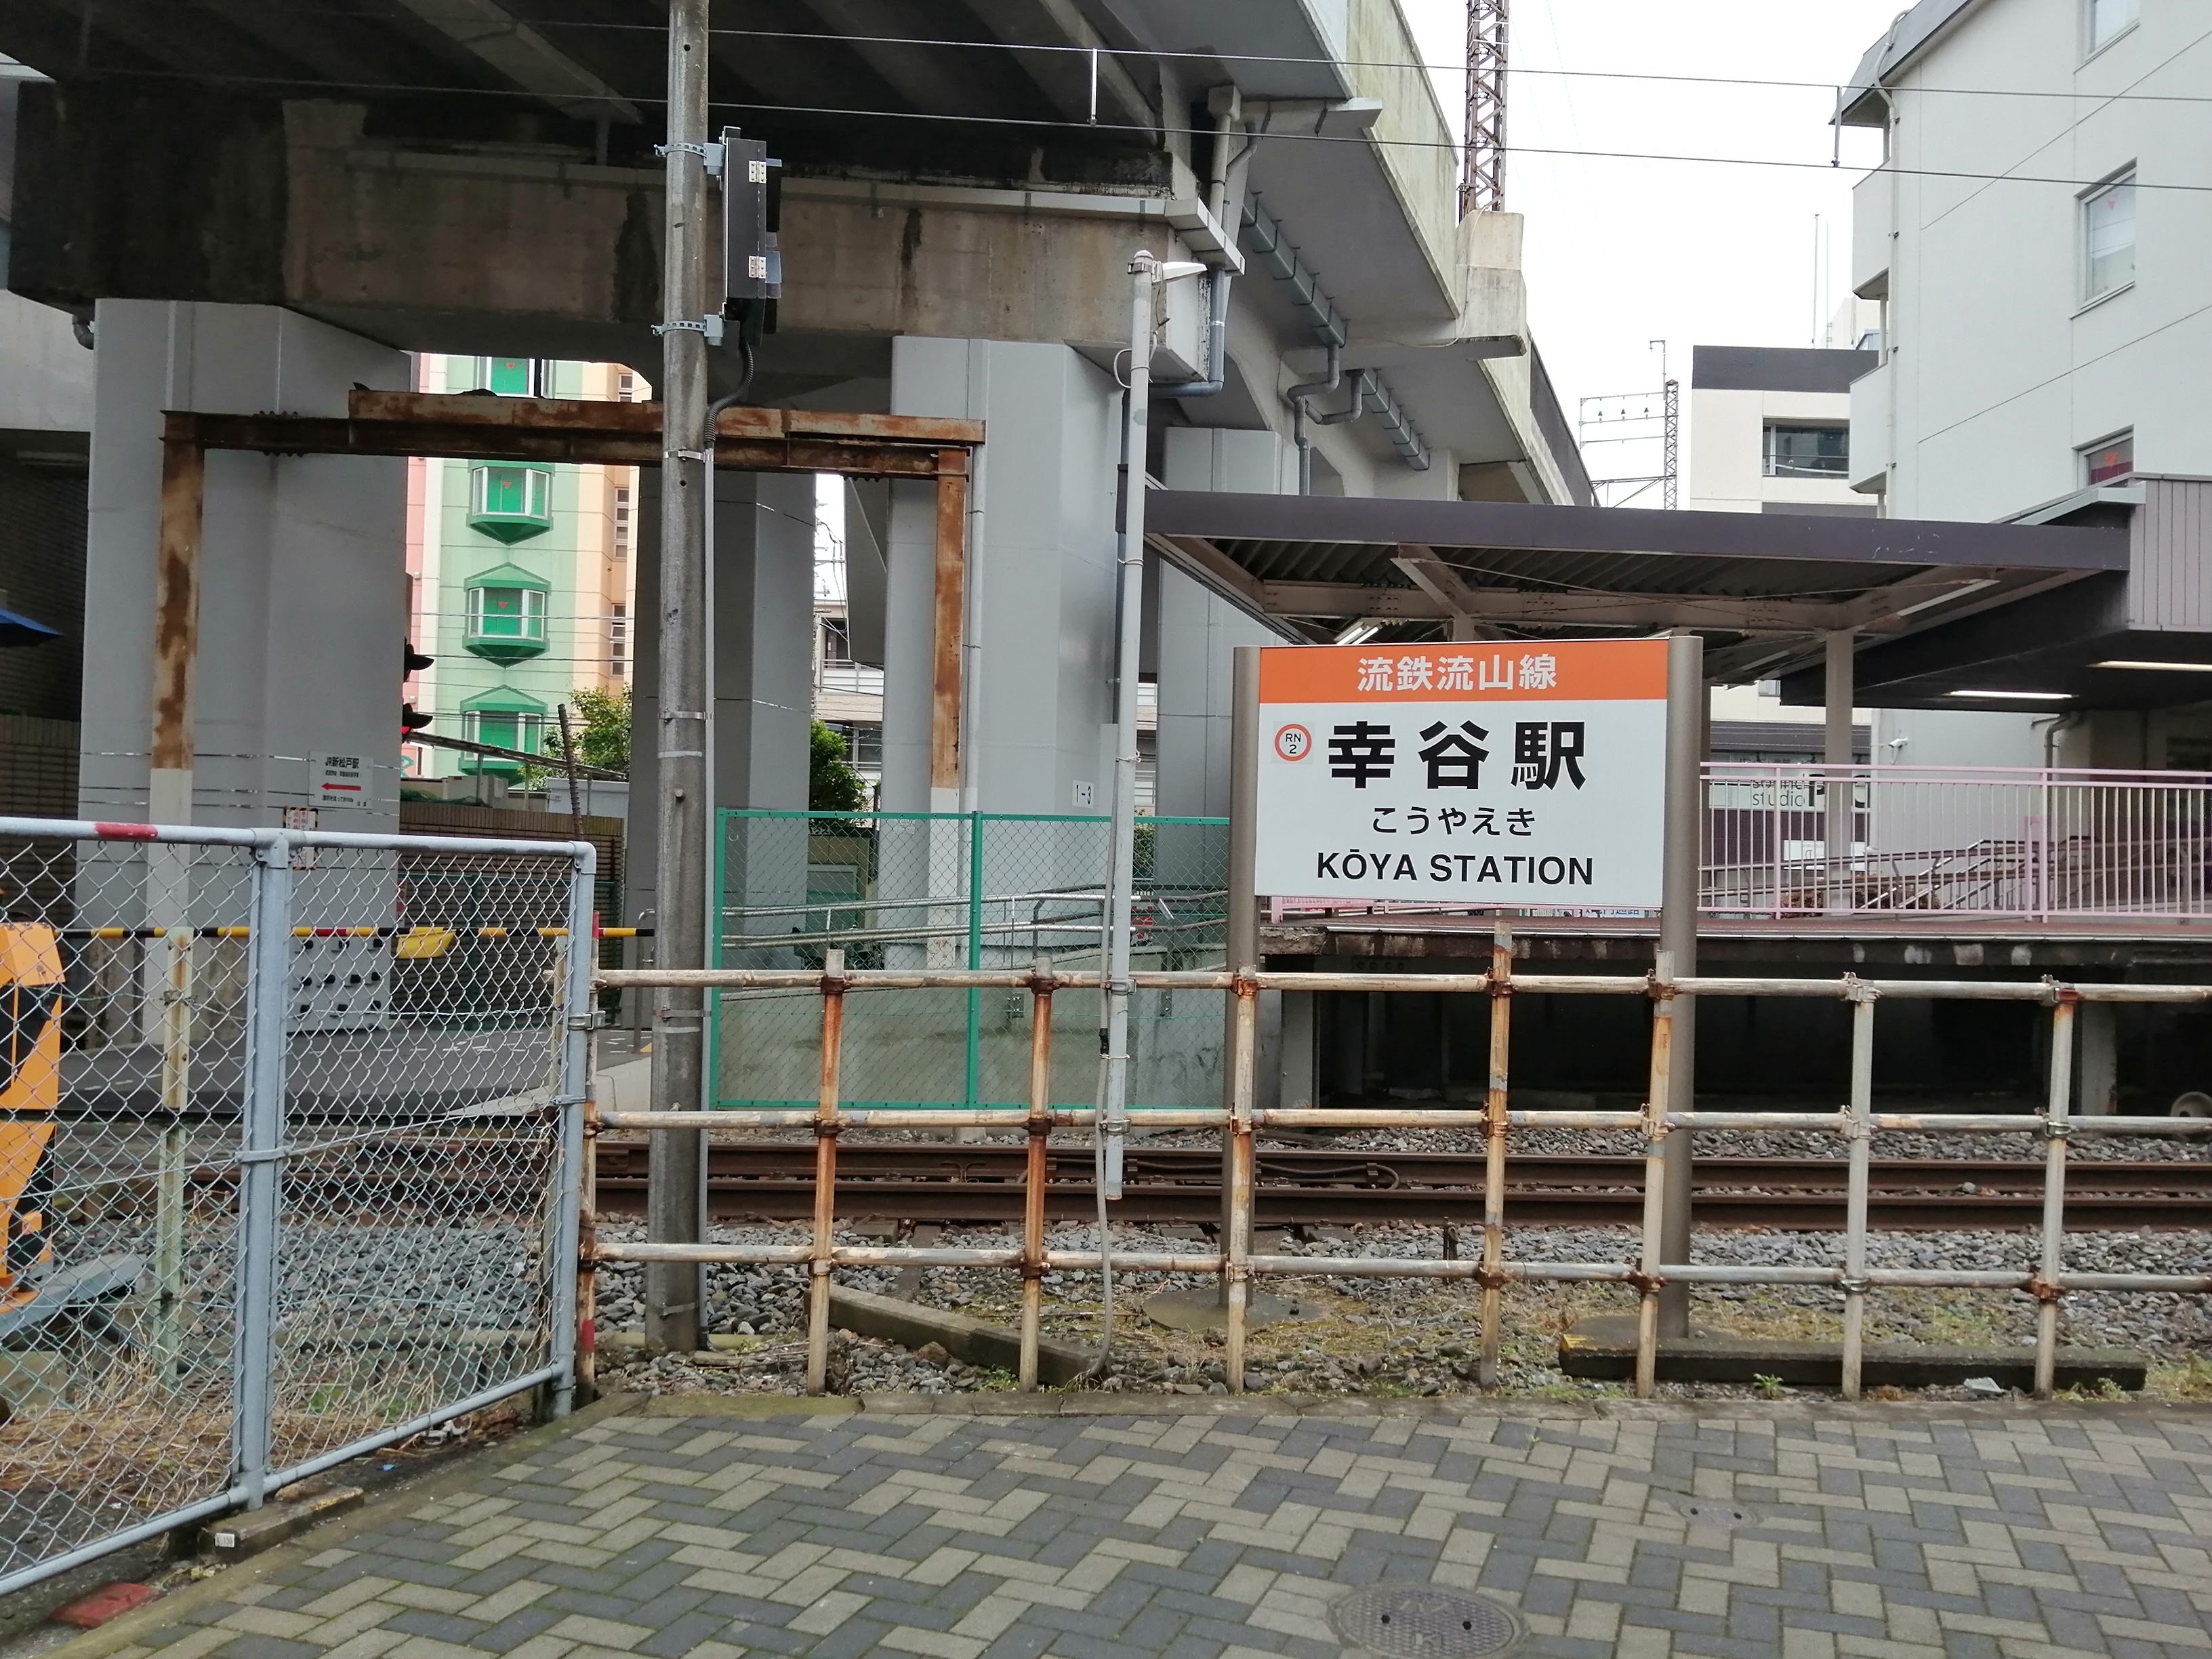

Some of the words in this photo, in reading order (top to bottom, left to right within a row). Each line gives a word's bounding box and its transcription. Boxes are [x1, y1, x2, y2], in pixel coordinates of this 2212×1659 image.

[1357, 653, 1557, 692] 流鉄流山線
[1286, 733, 1302, 742] RN
[1289, 744, 1297, 754] 2
[1328, 720, 1586, 791] 幸谷駅
[1076, 784, 1092, 805] 1-3
[1752, 791, 1805, 807] studio
[1372, 806, 1536, 836] こうやえき
[1317, 848, 1418, 881] KŌYA
[1429, 854, 1593, 885] STATION
